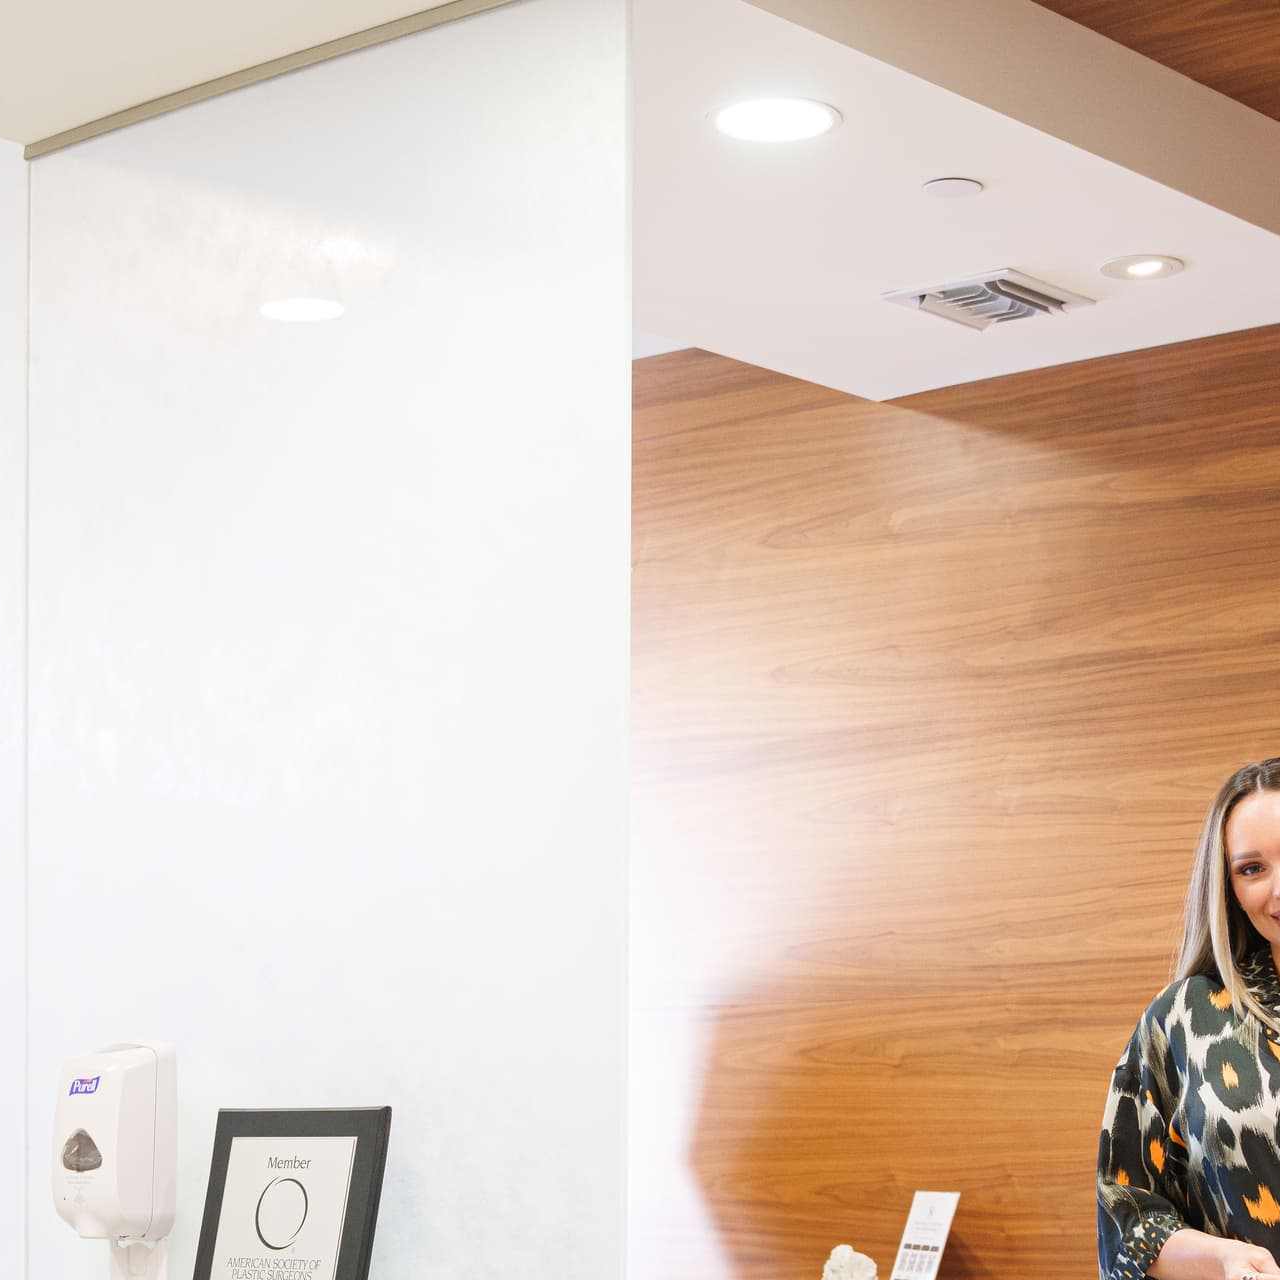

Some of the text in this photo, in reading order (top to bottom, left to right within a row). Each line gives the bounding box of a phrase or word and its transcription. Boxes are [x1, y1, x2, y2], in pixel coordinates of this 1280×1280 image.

[73, 1080, 97, 1092] Purell
[267, 1156, 312, 1169] Member
[226, 1257, 322, 1271] AMERICAN SOCIETY OF
[231, 1268, 265, 1280] PLASTIC
